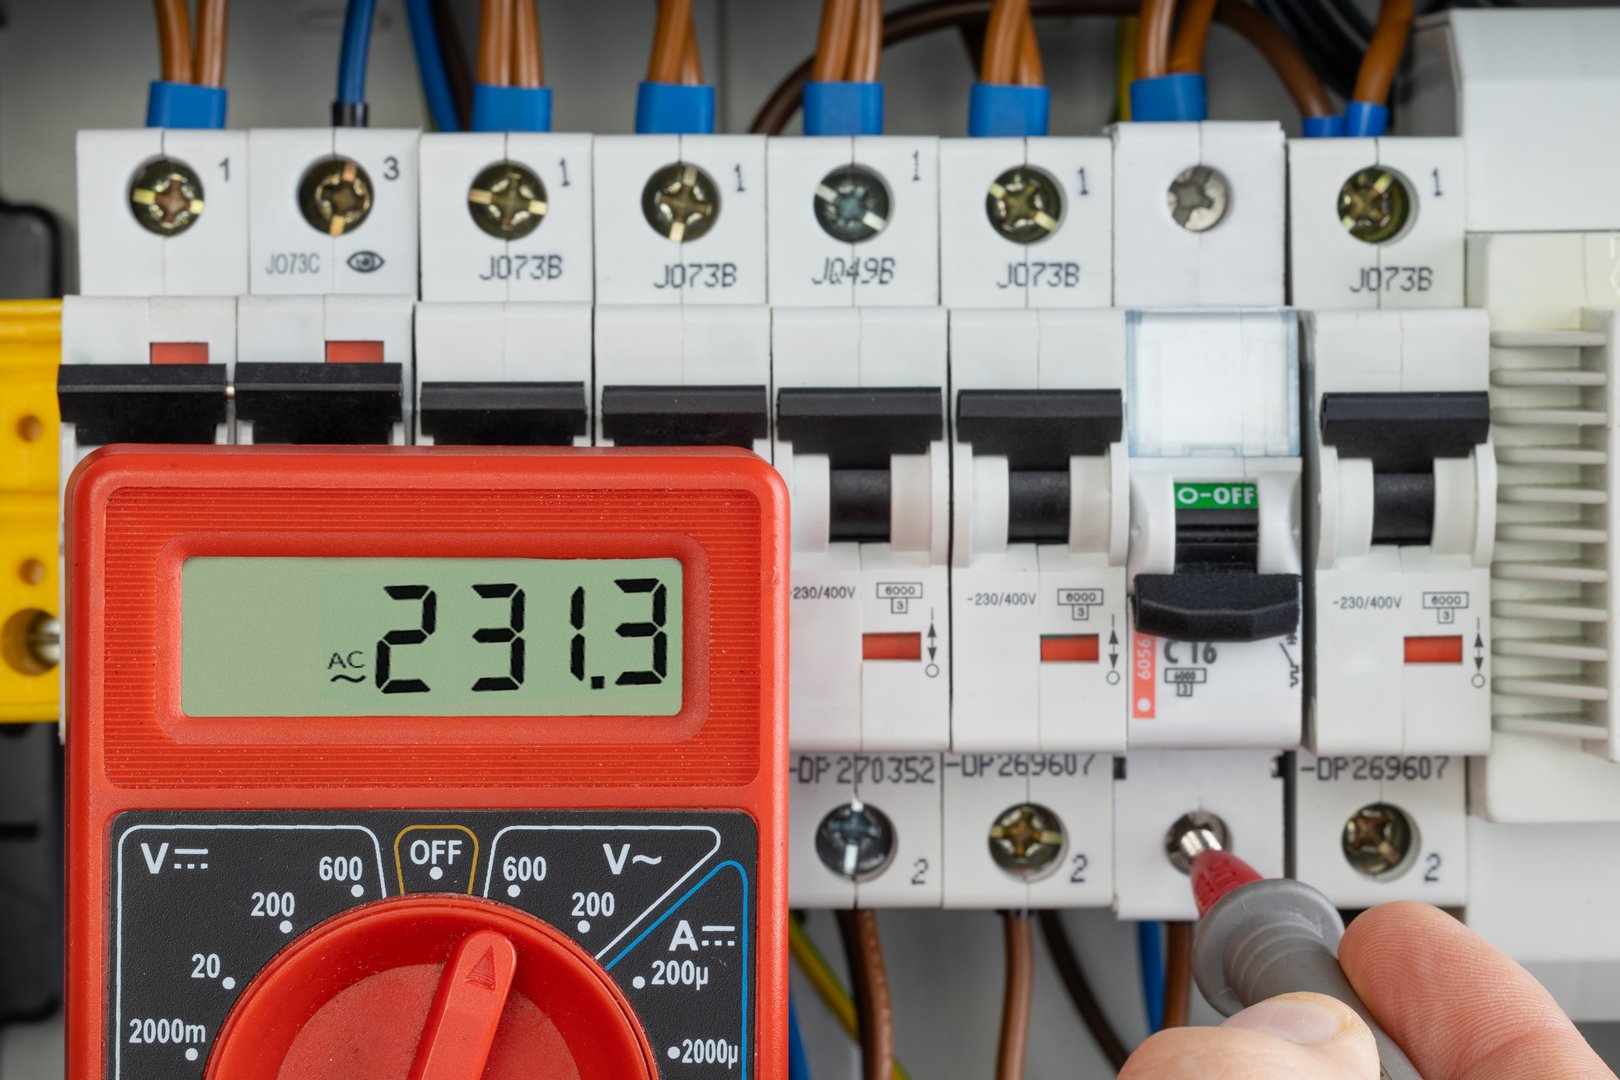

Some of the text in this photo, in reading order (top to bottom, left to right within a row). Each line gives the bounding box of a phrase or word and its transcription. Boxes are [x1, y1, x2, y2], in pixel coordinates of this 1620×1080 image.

[218, 157, 230, 182] 1
[383, 155, 400, 181] 3
[559, 158, 571, 187] 1
[733, 163, 746, 192] 1
[1077, 167, 1090, 196] 1
[1431, 168, 1443, 198] 1
[885, 586, 916, 596] 6000
[1066, 592, 1096, 602] 6000
[1431, 595, 1461, 605] 6000
[896, 600, 904, 610] 3
[1078, 607, 1085, 617] 3
[1442, 610, 1450, 621] 3
[375, 578, 668, 694] 231.3
[328, 651, 365, 669] AC
[1137, 639, 1151, 680] 6056
[410, 840, 463, 864] OFF
[319, 856, 363, 881] 600
[503, 856, 547, 881] 600
[910, 857, 929, 886] 2
[1070, 854, 1089, 884] 2
[1424, 854, 1442, 883] 2
[251, 892, 295, 917] 200
[571, 892, 615, 917] 200
[191, 953, 221, 978] 20
[129, 1018, 206, 1044] 2000m
